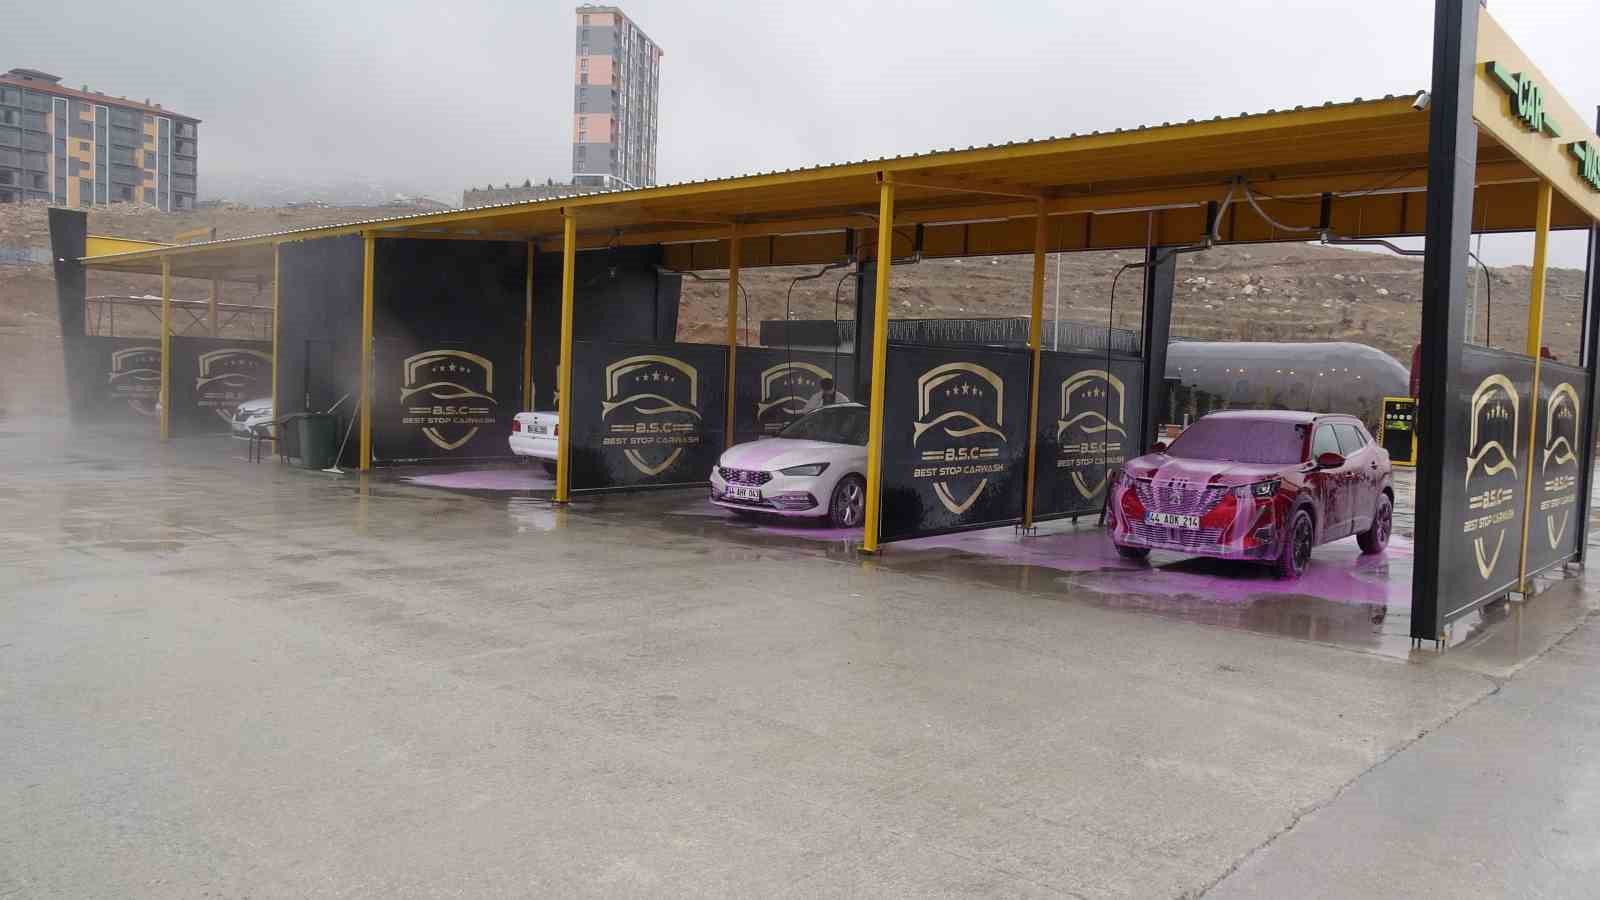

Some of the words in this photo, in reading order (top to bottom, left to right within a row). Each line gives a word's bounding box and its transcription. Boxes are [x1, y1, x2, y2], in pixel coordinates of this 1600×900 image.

[1515, 72, 1544, 132] CAR
[432, 406, 469, 415] B.S.C
[428, 417, 452, 425] STOP
[635, 422, 673, 433] B.S.C
[603, 437, 627, 445] BEST
[630, 437, 655, 445] STOP
[944, 447, 979, 461] B.S.C
[913, 467, 938, 478] BEST
[939, 466, 962, 476] STOP
[963, 463, 1005, 475] CARWASH
[1151, 512, 1161, 522] 44
